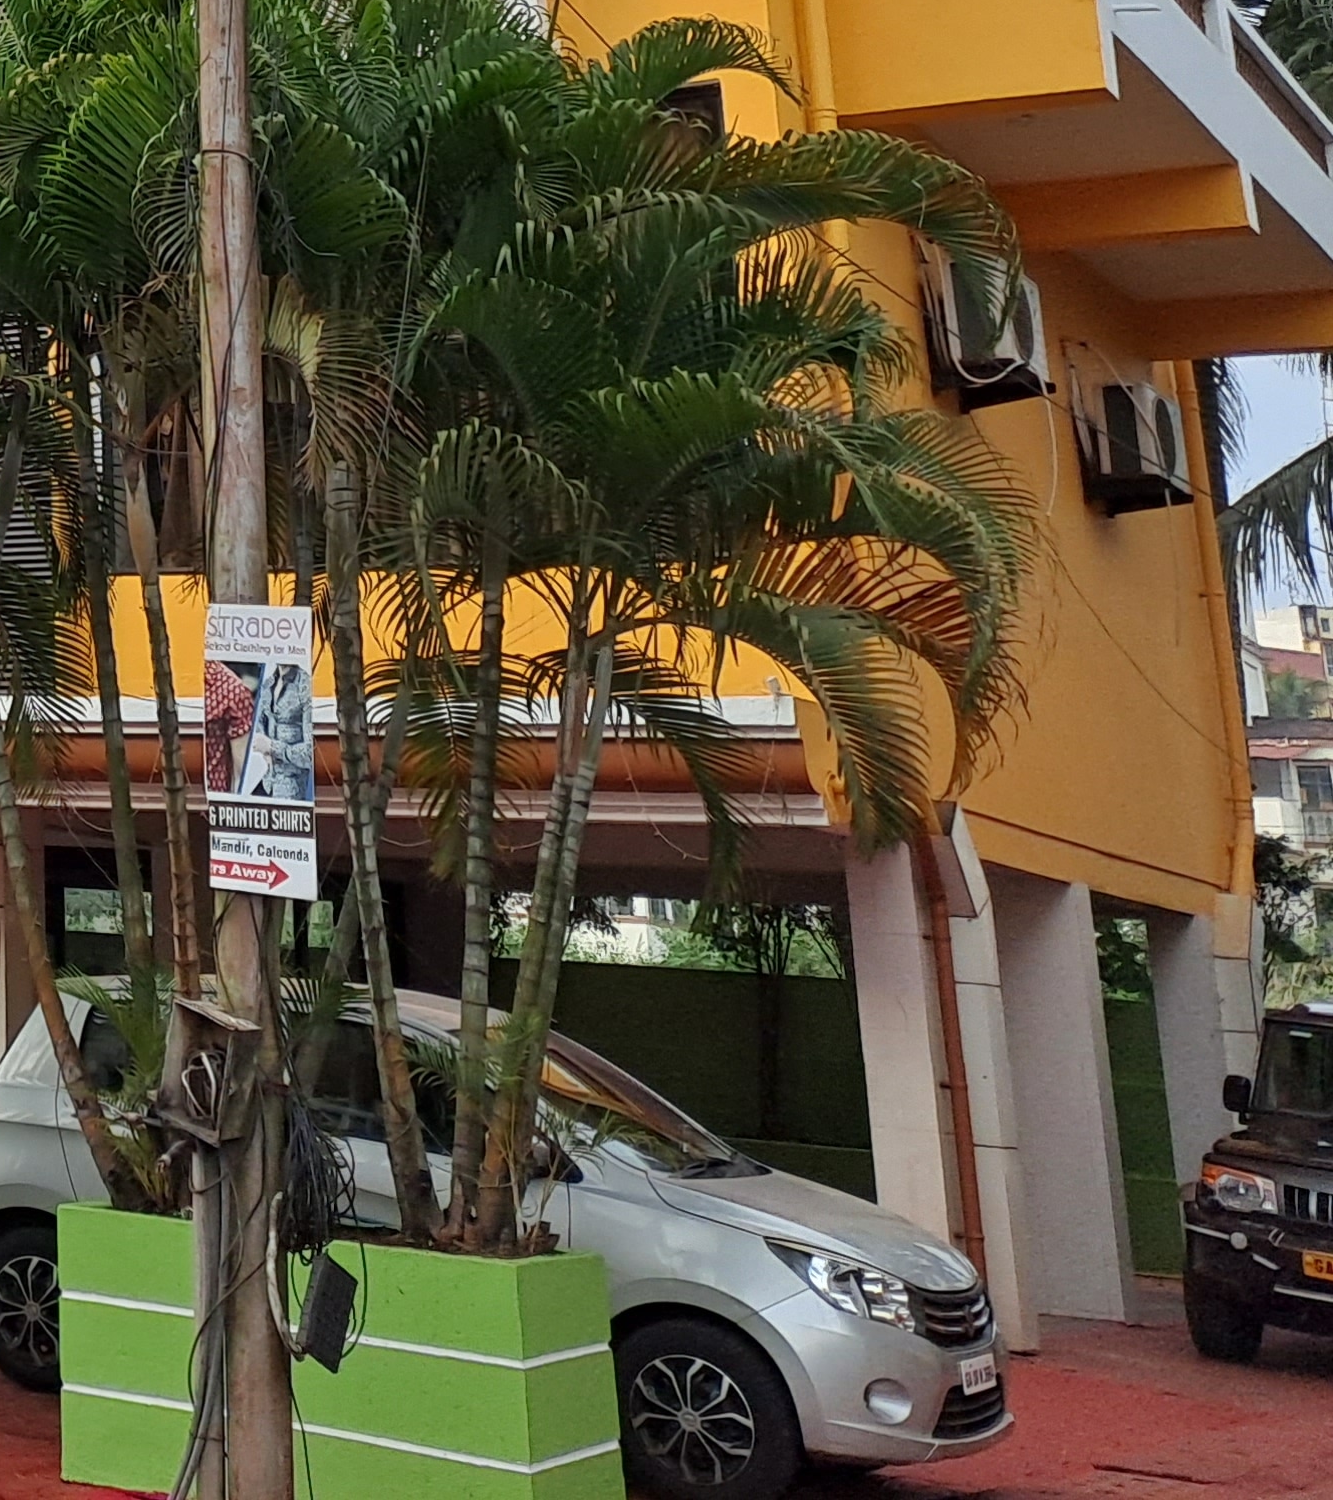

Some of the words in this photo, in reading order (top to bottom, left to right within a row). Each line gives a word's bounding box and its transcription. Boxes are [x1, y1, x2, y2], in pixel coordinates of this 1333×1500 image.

[233, 641, 271, 656] Clothing
[288, 645, 307, 656] Men
[208, 806, 217, 826] &
[218, 806, 269, 830] PRINTED
[271, 809, 311, 833] SHIRTS
[230, 863, 277, 884] Away
